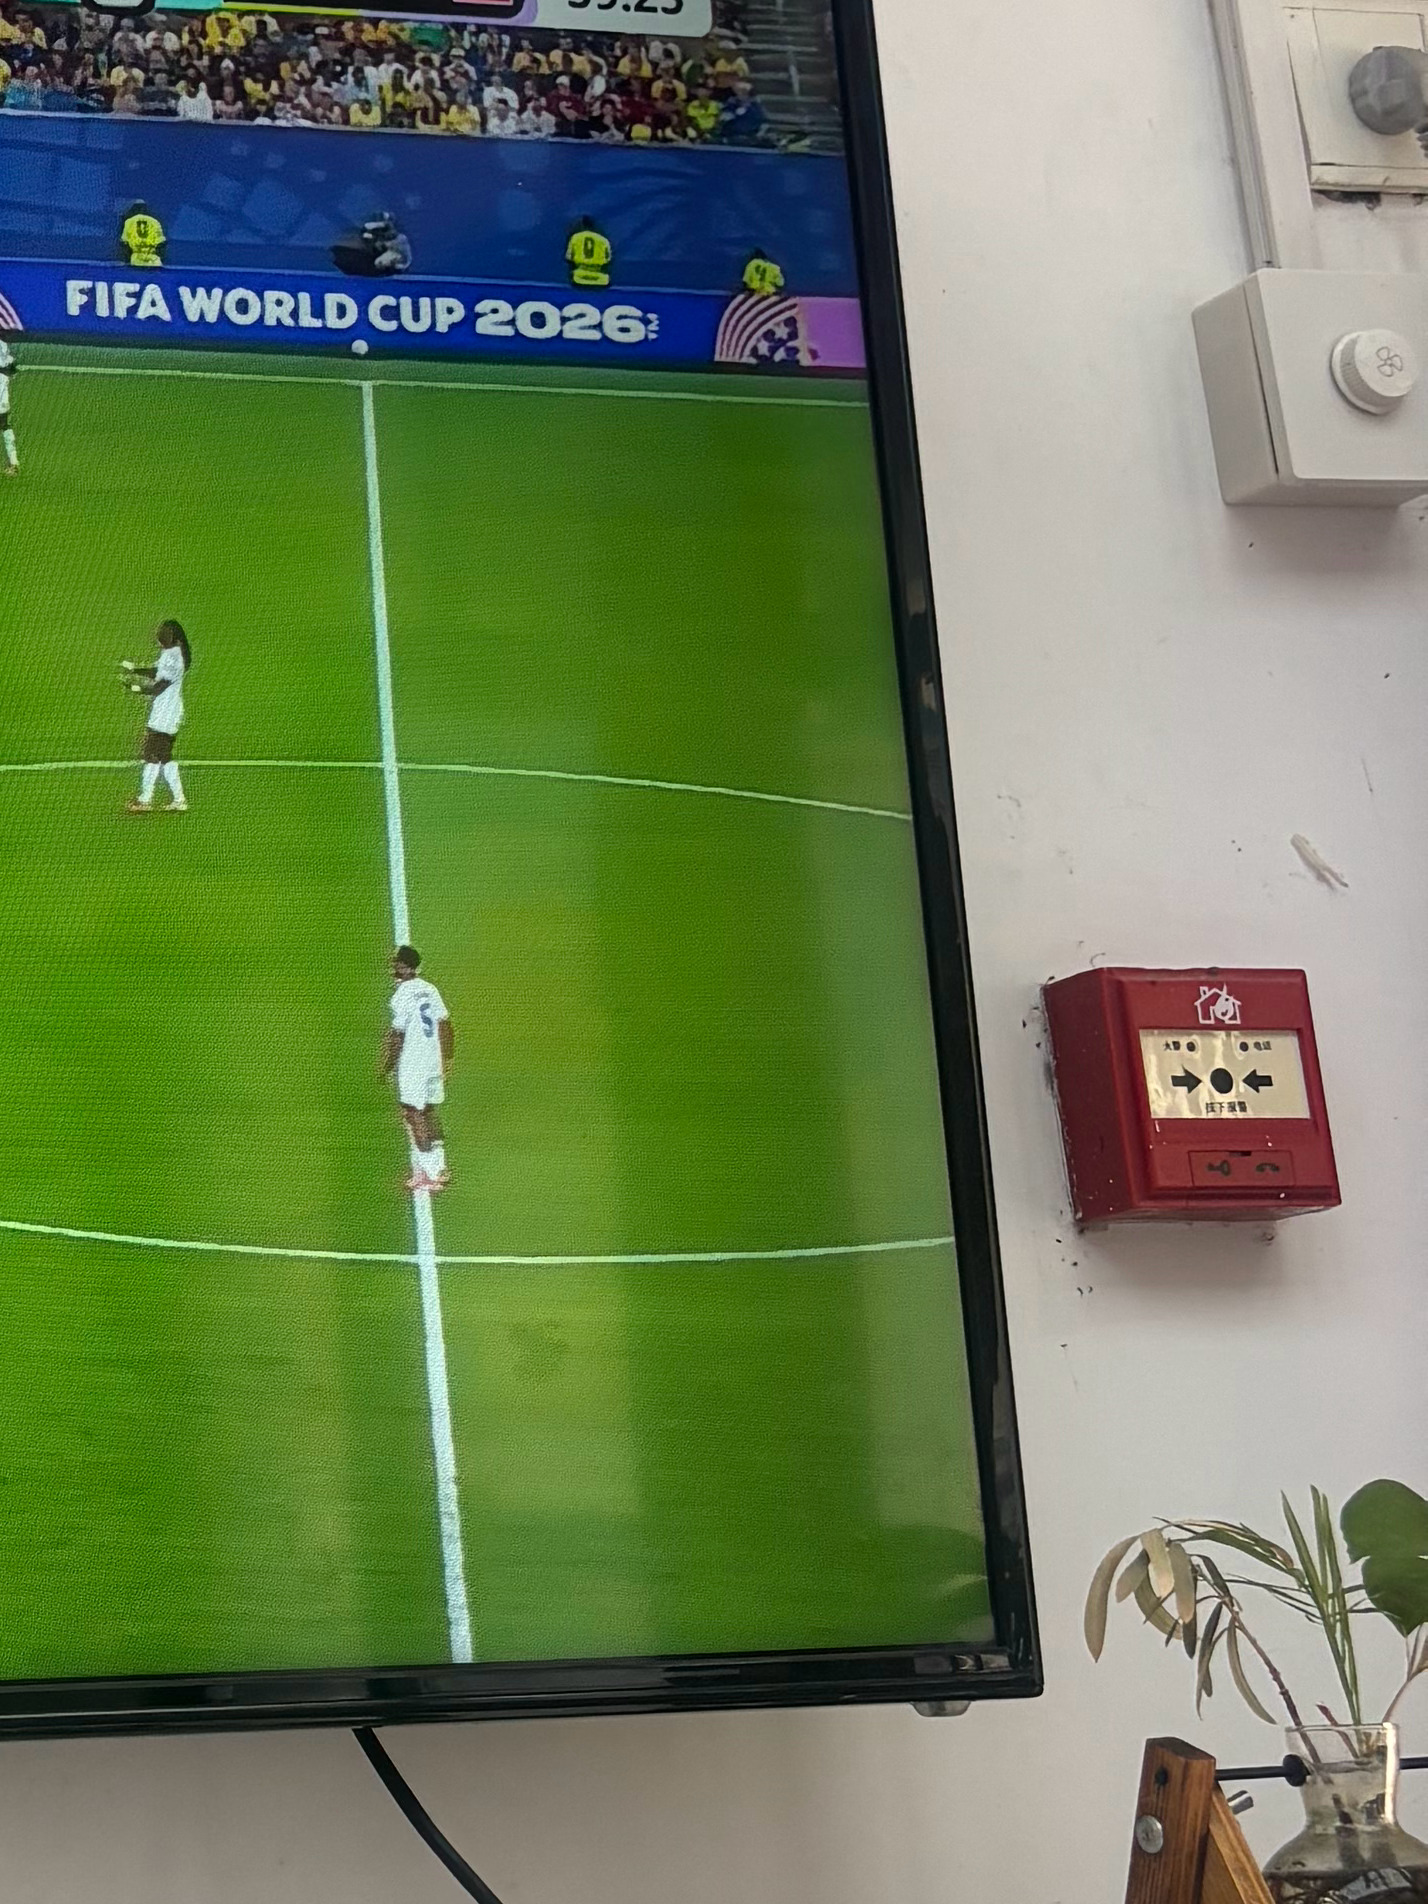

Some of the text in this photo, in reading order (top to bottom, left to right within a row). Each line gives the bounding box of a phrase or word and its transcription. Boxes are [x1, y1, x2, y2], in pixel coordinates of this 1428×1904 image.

[66, 280, 170, 321] FIFA
[176, 287, 354, 333] WORLD
[367, 294, 464, 337] CUP
[1205, 1101, 1248, 1114] 按下报警
